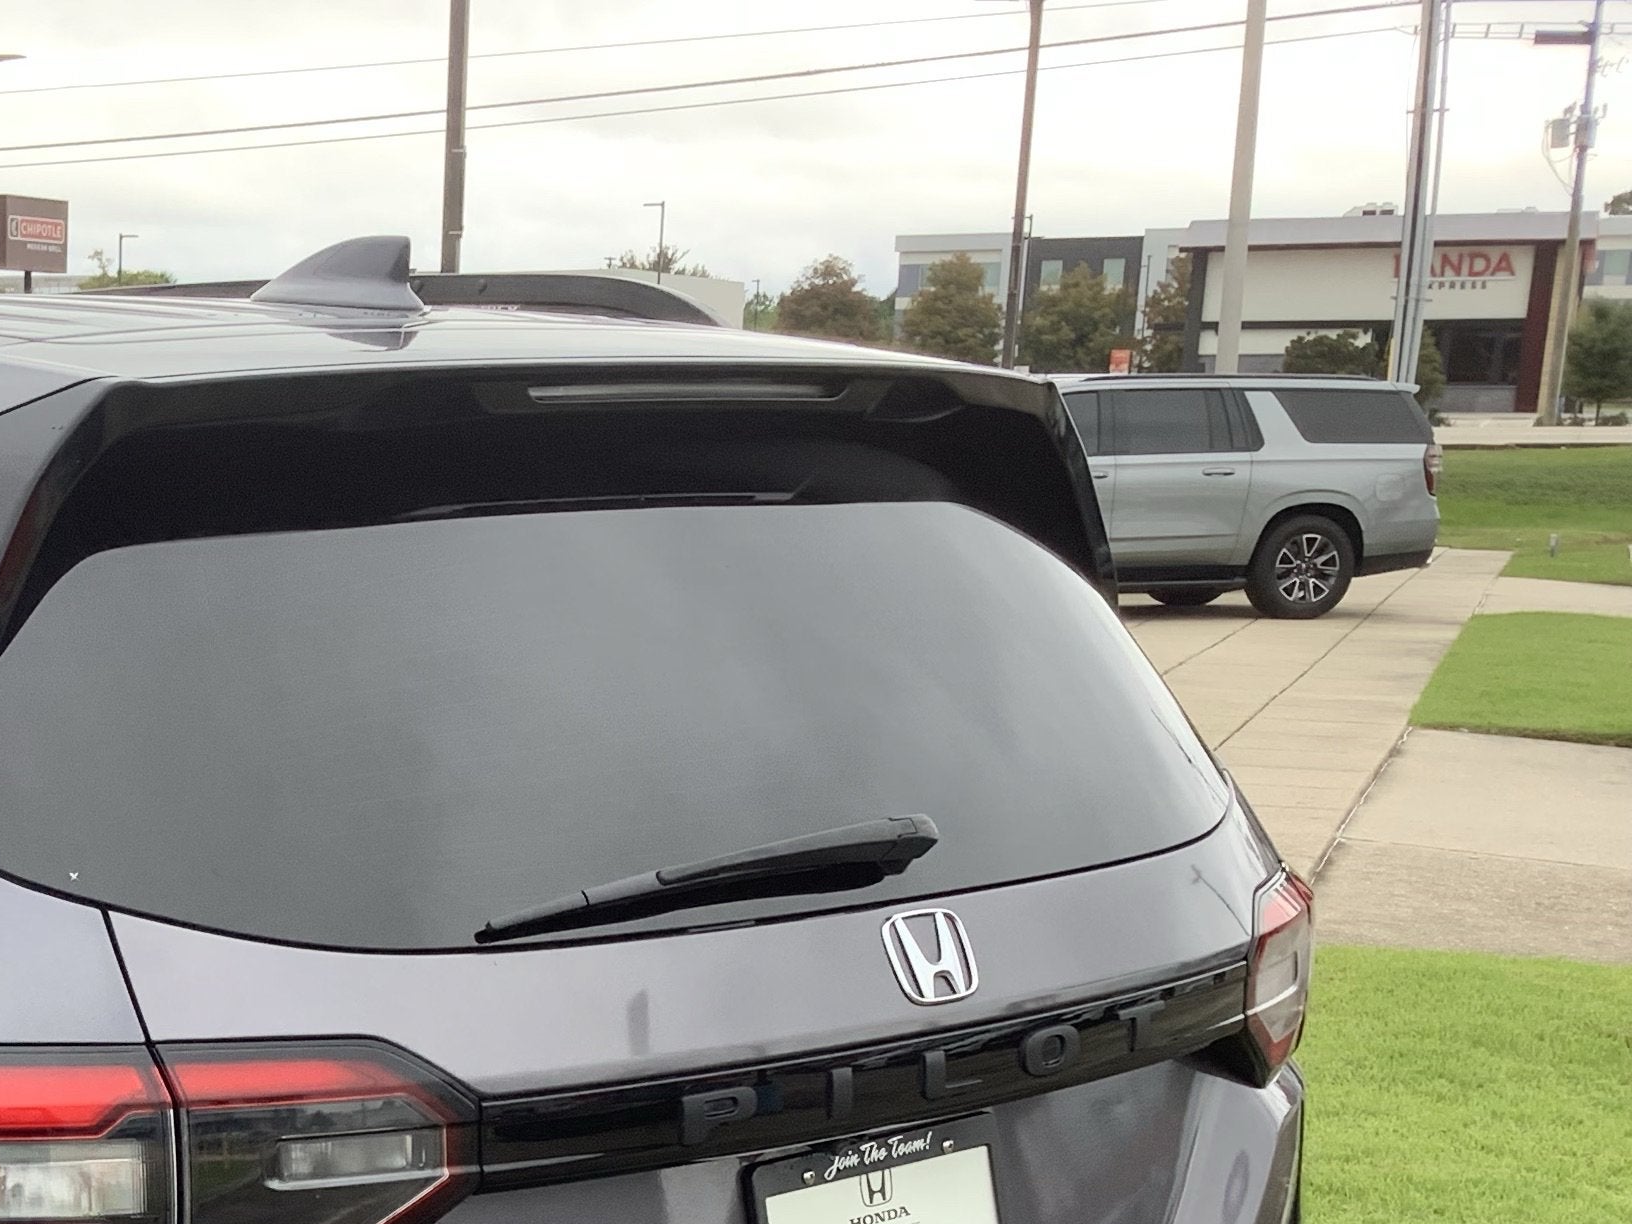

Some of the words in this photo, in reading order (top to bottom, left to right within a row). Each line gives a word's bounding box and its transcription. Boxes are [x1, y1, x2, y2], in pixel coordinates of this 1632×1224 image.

[20, 221, 63, 239] CHIPOTLE
[1393, 251, 1516, 279] NDA
[680, 998, 1166, 1146] PILOT
[823, 1151, 860, 1181] Join
[859, 1141, 888, 1166] The
[887, 1131, 934, 1160] Team!
